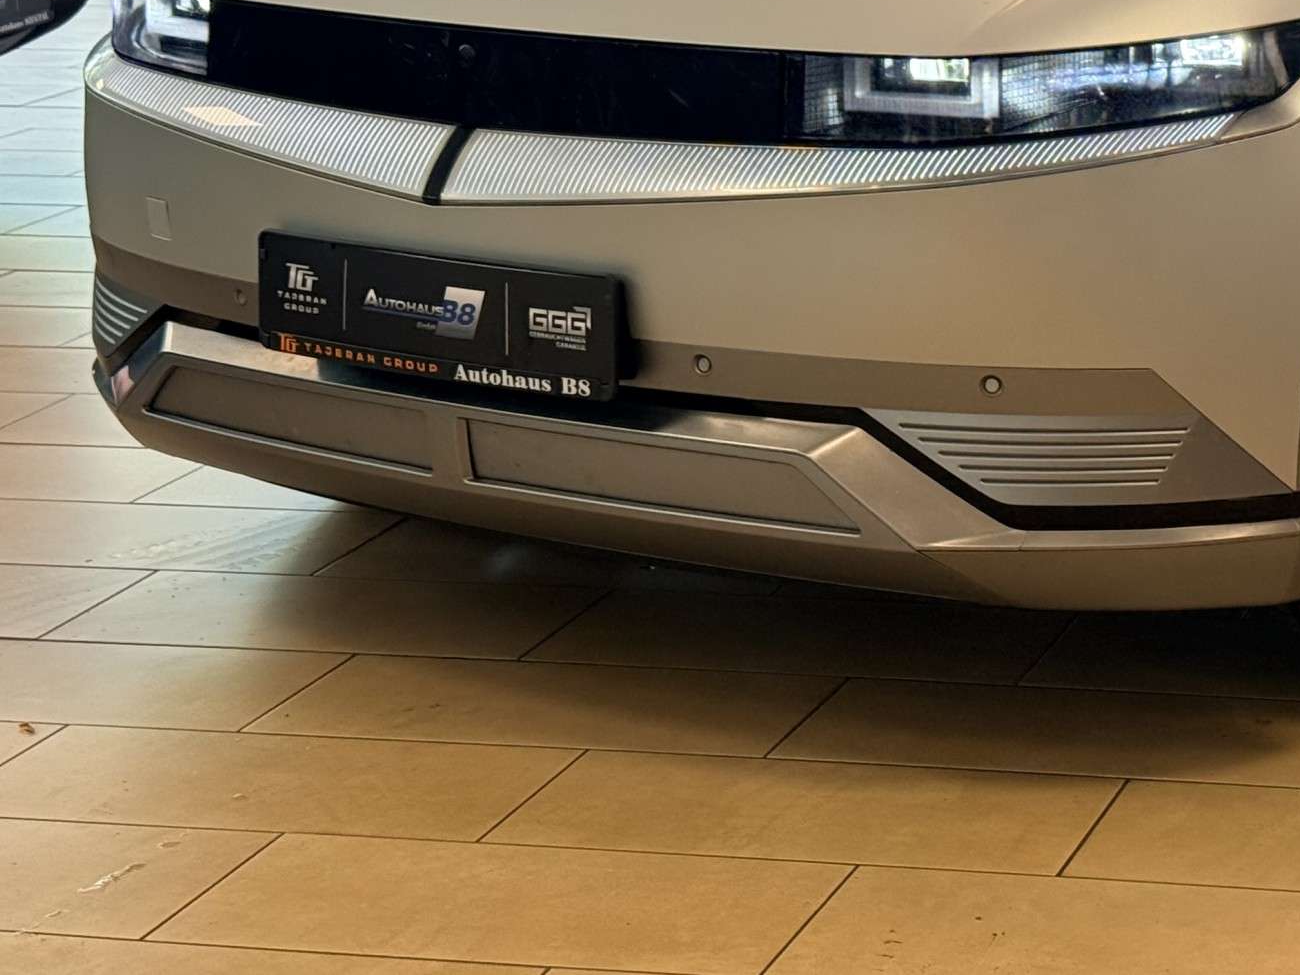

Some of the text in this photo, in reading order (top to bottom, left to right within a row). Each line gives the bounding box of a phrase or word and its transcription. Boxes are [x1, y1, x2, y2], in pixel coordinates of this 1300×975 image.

[361, 288, 445, 317] AUTOHAUS
[528, 306, 589, 336] GGG
[304, 342, 376, 364] TAJERAN
[383, 356, 439, 373] GROUP
[454, 363, 591, 397] Autohaus B8
